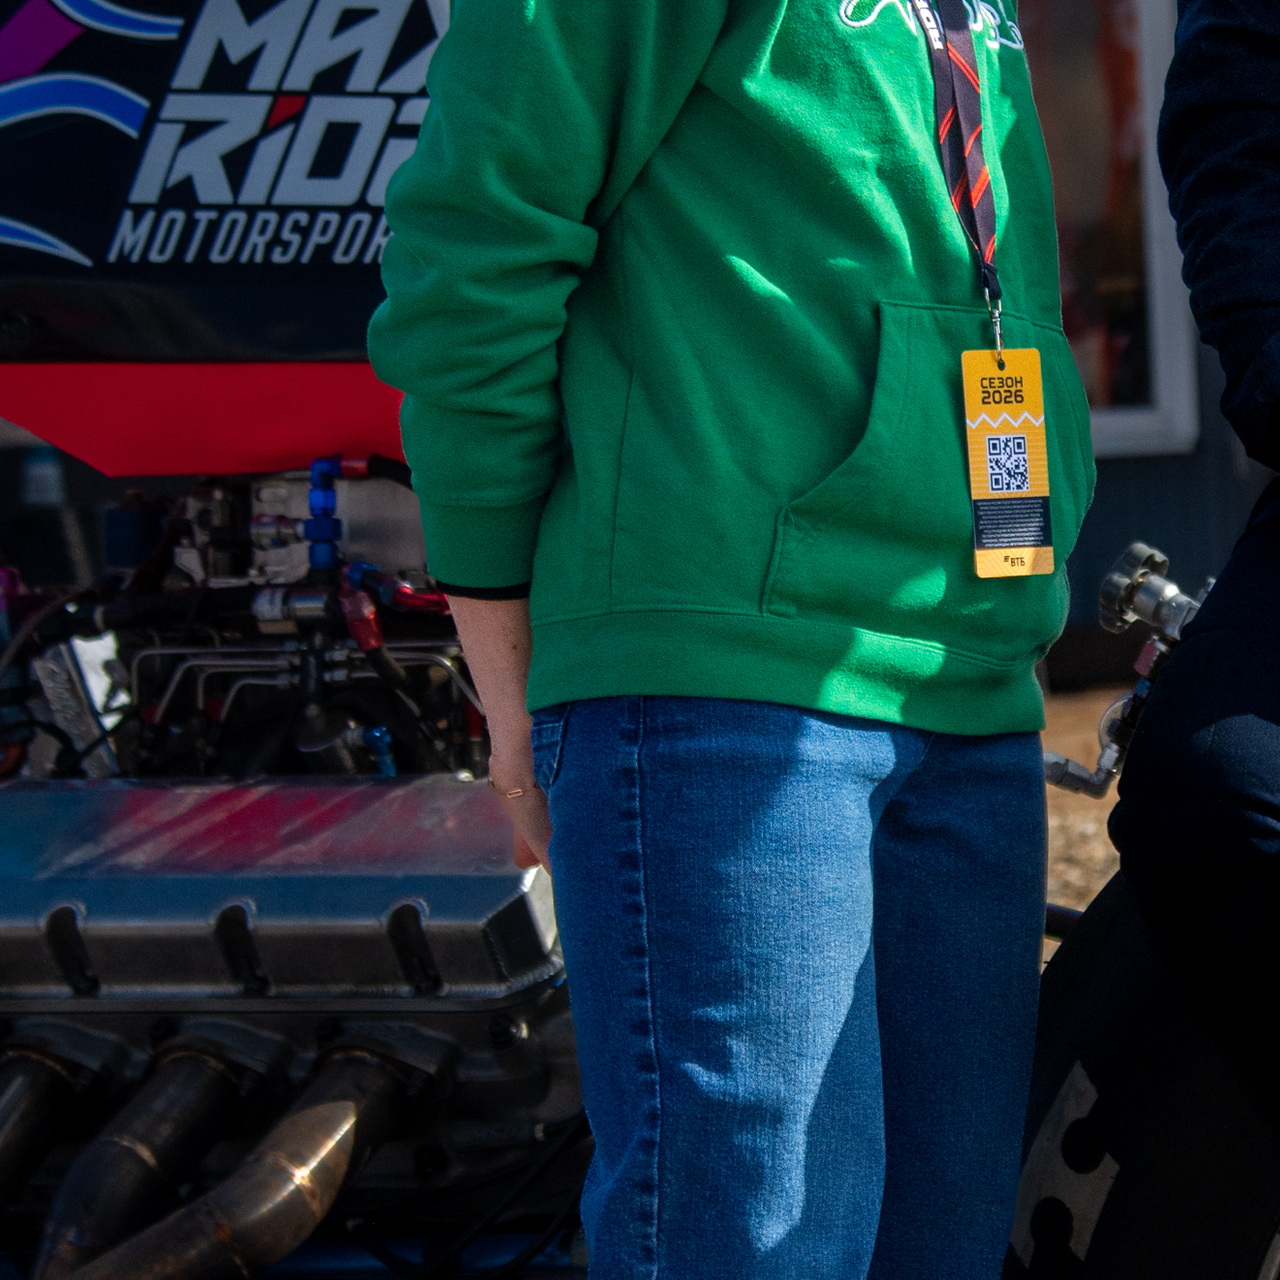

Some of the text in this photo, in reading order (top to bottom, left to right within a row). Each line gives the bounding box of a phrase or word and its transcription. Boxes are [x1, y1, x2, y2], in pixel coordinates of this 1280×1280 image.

[106, 207, 396, 264] MOTORSPOR
[980, 376, 1023, 389] СЕЗОН
[981, 389, 1024, 405] 2026
[1010, 557, 1026, 567] ВТБ
